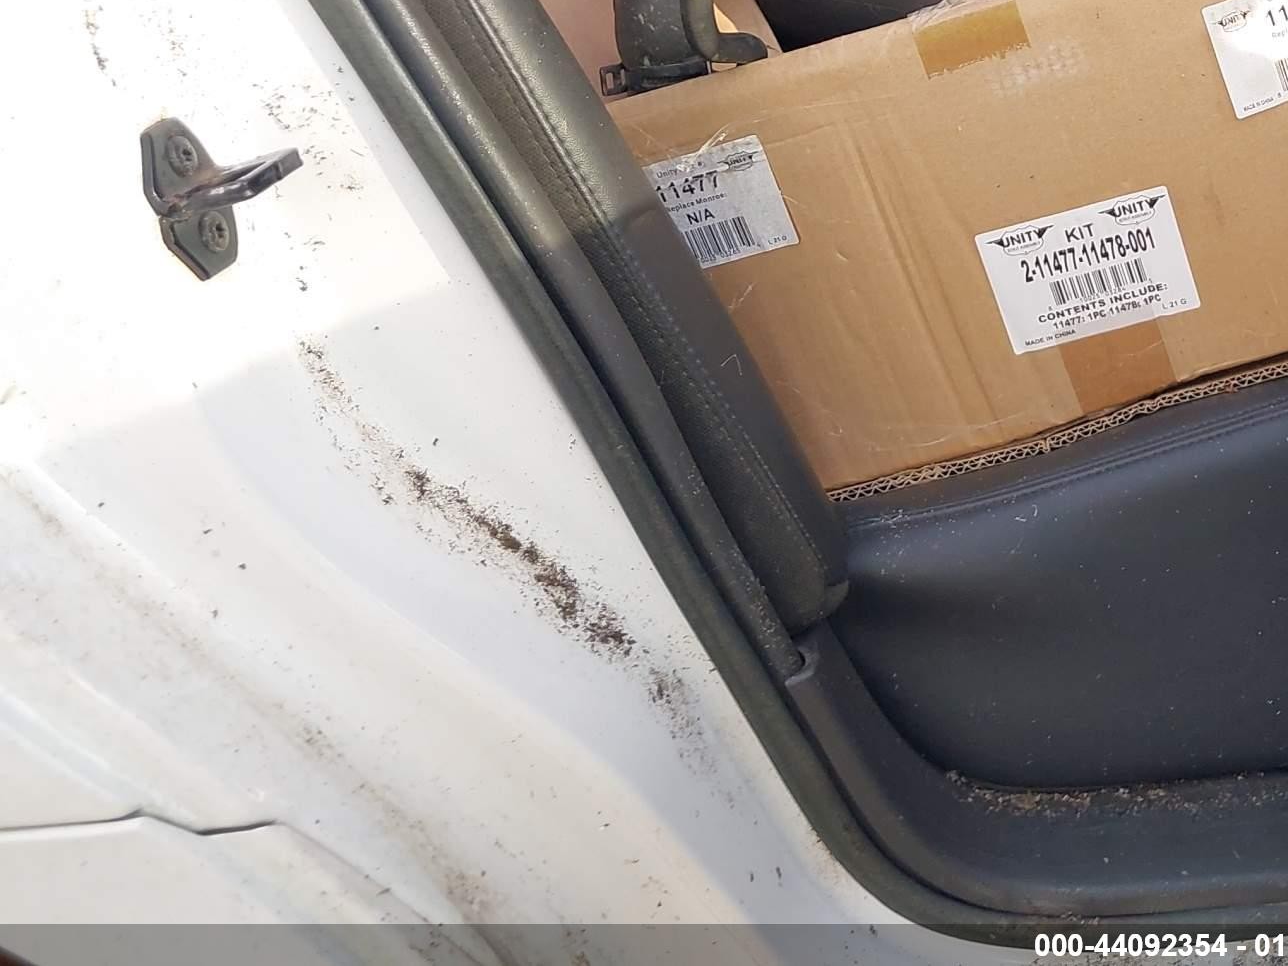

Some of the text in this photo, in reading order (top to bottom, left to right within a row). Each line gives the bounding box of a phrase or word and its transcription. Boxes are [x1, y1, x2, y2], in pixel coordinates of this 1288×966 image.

[656, 168, 679, 179] Unity
[655, 170, 719, 203] 11477
[685, 208, 716, 226] N/A
[1113, 197, 1157, 218] UNITY
[1002, 227, 1046, 248] UNITY
[1065, 223, 1094, 243] KIT
[1021, 227, 1155, 283] 2-11477-11478-001
[1038, 282, 1169, 323] CONTENTS INCLUDE:
[1053, 293, 1162, 329] 11477: 1PC 11478: 1PC
[1162, 302, 1168, 310] L
[1169, 300, 1179, 308] 21
[1024, 337, 1045, 346] MADE
[1054, 328, 1077, 339] CHINA
